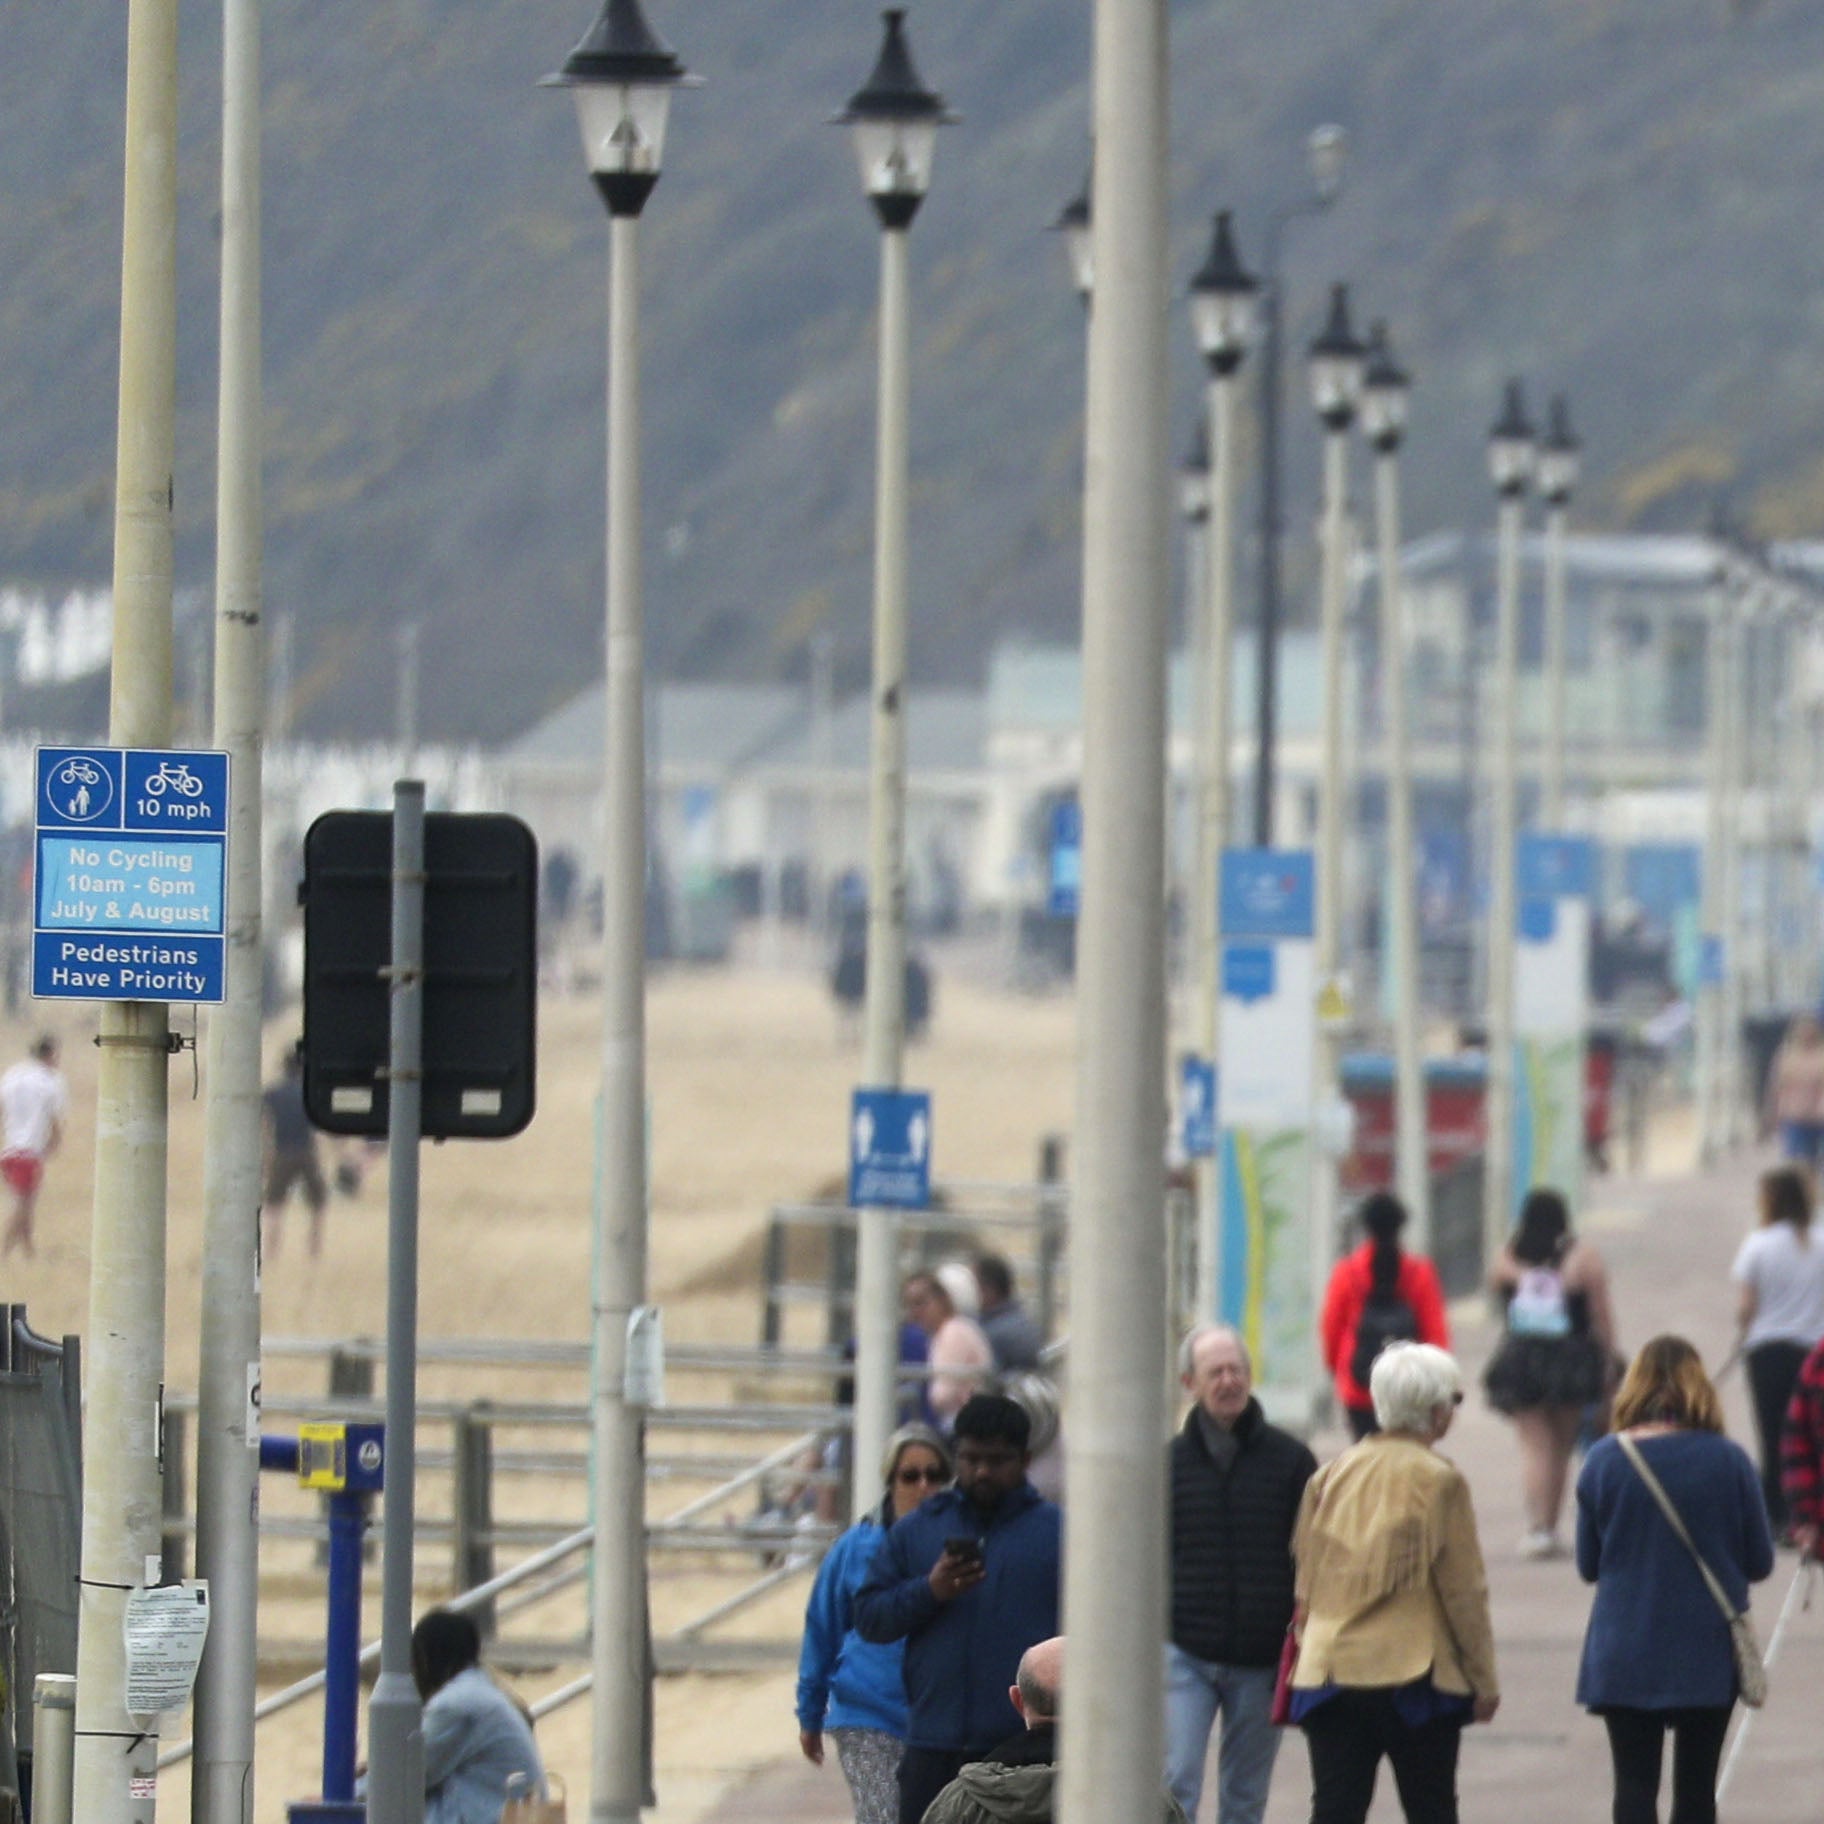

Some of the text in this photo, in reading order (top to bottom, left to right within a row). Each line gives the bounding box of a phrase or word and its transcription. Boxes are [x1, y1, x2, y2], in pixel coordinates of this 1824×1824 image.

[137, 799, 211, 820] 10 mph
[69, 848, 193, 872] No Cycling
[67, 875, 125, 893] 10am
[148, 876, 195, 897] 6pm
[51, 901, 210, 924] July & August
[61, 942, 198, 964] Pedestrians
[52, 968, 206, 994] Have Priority
